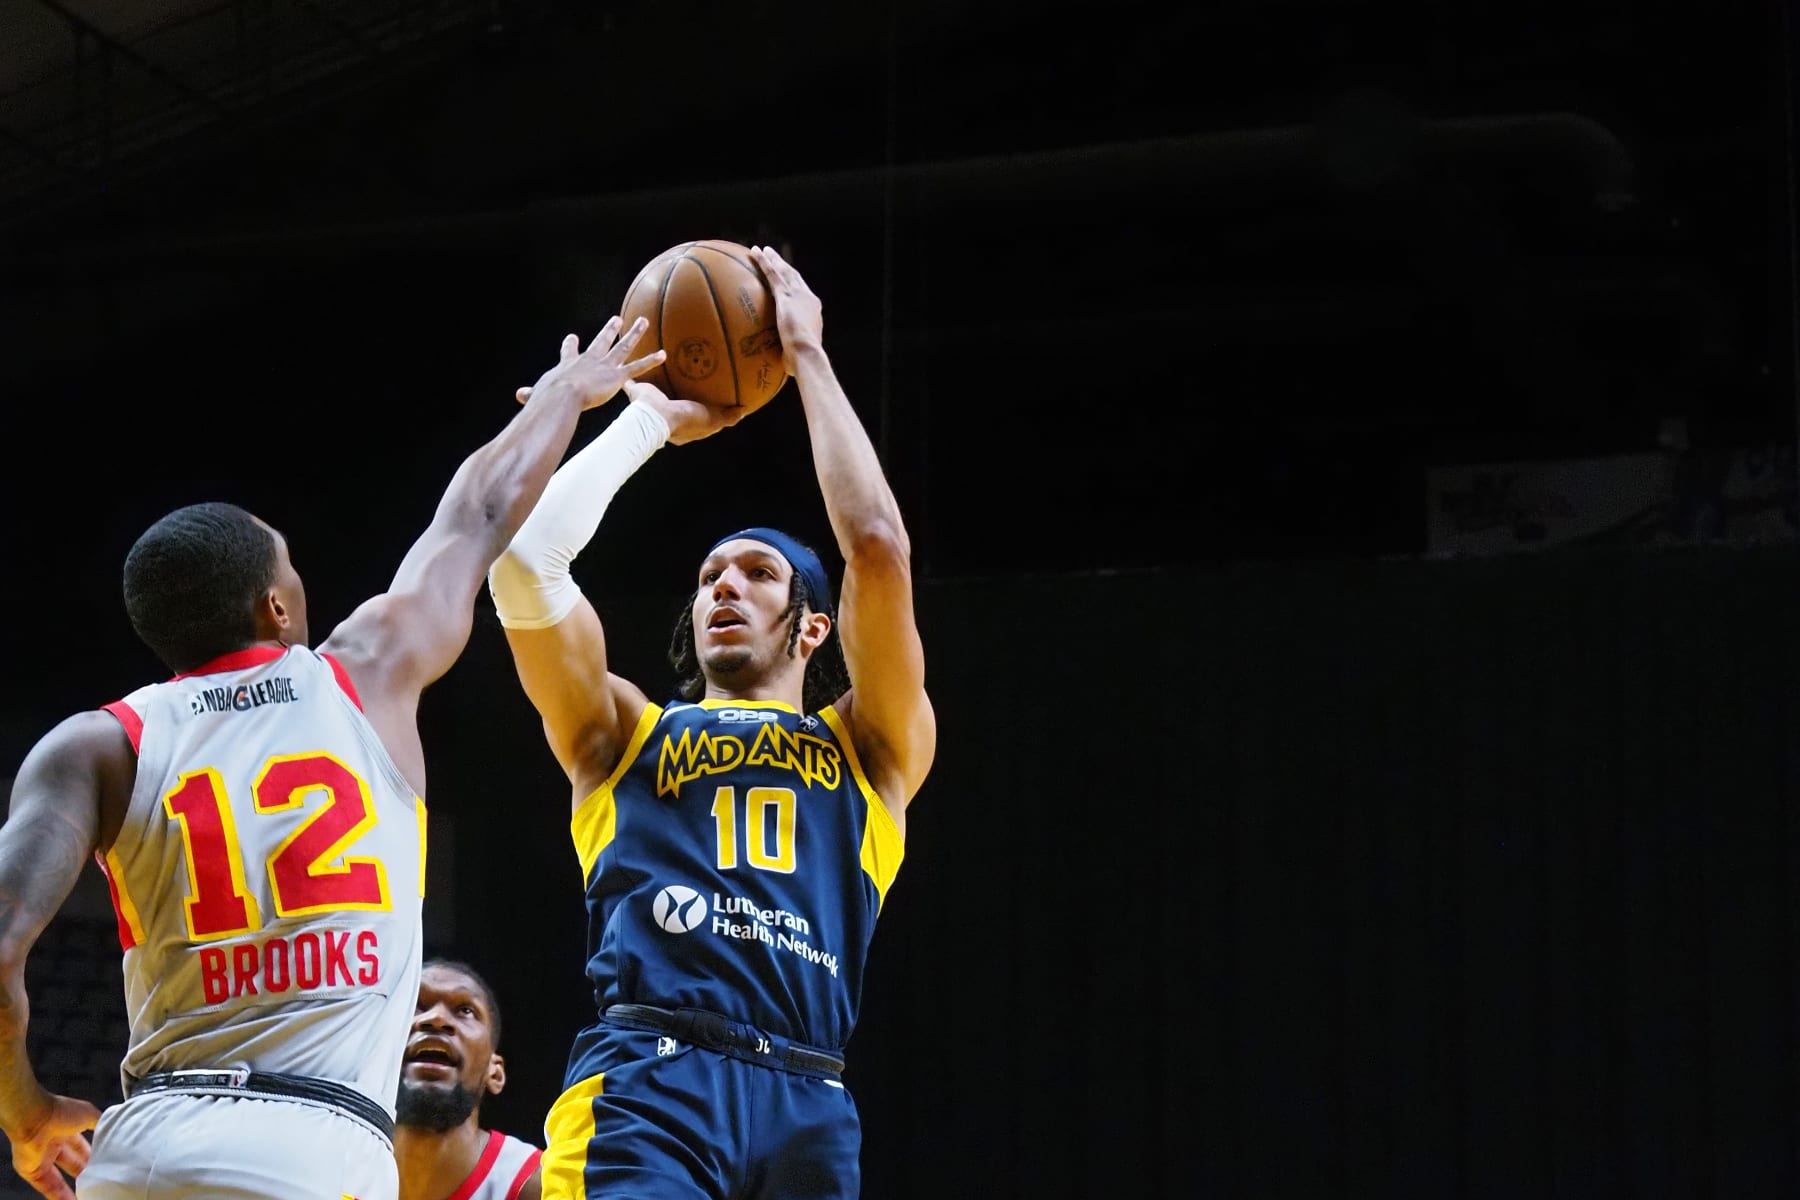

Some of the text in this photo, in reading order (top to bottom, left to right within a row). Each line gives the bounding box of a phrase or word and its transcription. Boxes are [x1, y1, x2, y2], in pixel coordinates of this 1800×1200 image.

[657, 722, 840, 798] MAD ANTS
[162, 751, 393, 941] 12
[711, 786, 795, 873] 10
[712, 916, 774, 947] Health
[713, 893, 809, 935] Lutheran
[201, 931, 379, 1005] BROOKS
